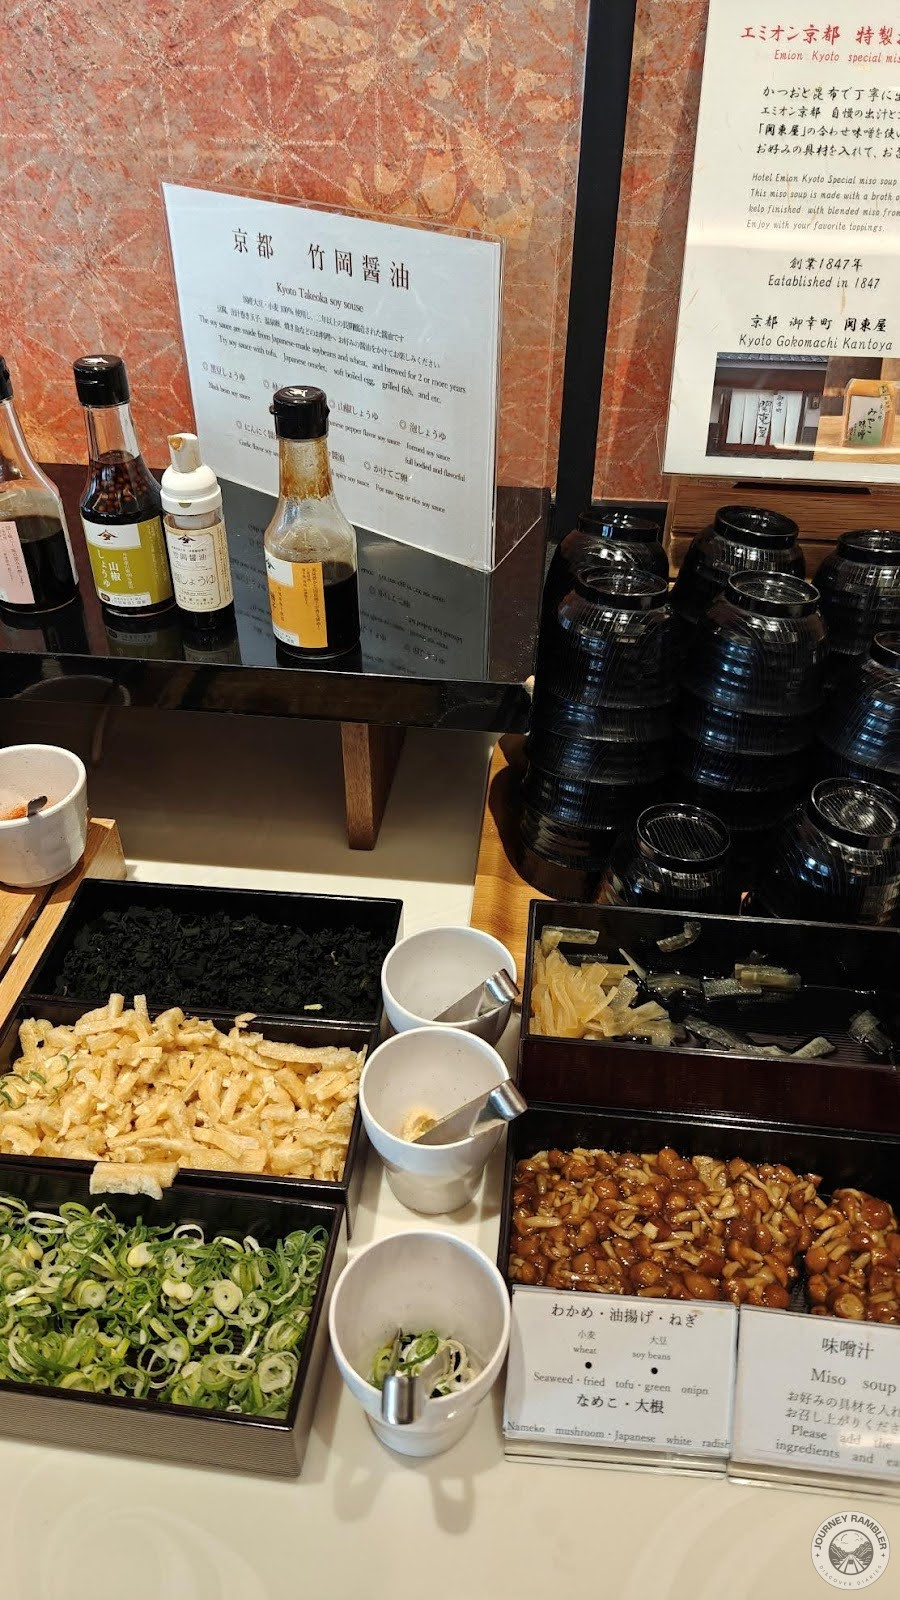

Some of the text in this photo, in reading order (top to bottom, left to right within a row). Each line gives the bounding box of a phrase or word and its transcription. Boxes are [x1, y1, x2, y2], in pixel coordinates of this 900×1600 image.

[741, 24, 900, 46] エミオン京都 特製
[774, 49, 803, 61] Emion
[812, 50, 840, 63] Kyoto
[848, 51, 882, 64] special
[761, 106, 821, 119] エミオン京都
[751, 173, 897, 187] Hotel Emion Kyoto Special miso soup
[750, 188, 766, 198] This
[770, 189, 787, 198] miso
[790, 191, 807, 199] soup
[810, 190, 817, 199] is
[821, 191, 840, 199] made
[844, 191, 860, 200] with
[871, 191, 892, 201] broth
[767, 204, 801, 214] finished
[808, 205, 824, 214] with
[828, 206, 860, 215] blended
[863, 207, 880, 216] miso
[747, 220, 885, 233] Enjoy with your favorite toppings.
[232, 227, 410, 290] 京都 竹岡醤油
[789, 256, 863, 272] 創業1847年
[837, 275, 848, 288] in
[854, 277, 881, 290] 1847
[276, 282, 364, 313] Kyoto Takeoka soy souse
[750, 314, 887, 332] 京都 御幸町 関東屋
[739, 334, 893, 352] Kyoto Gokomachi Kantoya
[199, 314, 209, 324] The
[210, 319, 218, 328] soy
[242, 328, 257, 337] made
[258, 330, 271, 341] from
[312, 347, 337, 359] soybeans
[338, 353, 348, 362] and
[372, 361, 383, 373] and
[384, 364, 406, 379] brewed
[407, 370, 417, 381] for
[423, 376, 430, 384] or
[431, 379, 449, 390] more
[449, 383, 467, 394] years
[218, 335, 228, 344] Try
[229, 340, 238, 349] soy
[283, 352, 307, 367] Japanese
[333, 367, 345, 378] soft
[345, 369, 363, 382] boiled
[382, 381, 400, 393] grilled
[417, 391, 430, 401] and
[551, 1303, 699, 1328] わかめ・油揚げ・ねぎ
[577, 1329, 669, 1346] 小麦 大豆
[573, 1345, 672, 1361] wheat soy beans
[821, 1337, 875, 1360] 味噌汁
[810, 1367, 897, 1397] Miso soup
[576, 1393, 665, 1415] なめこ・大根
[507, 1421, 546, 1433] Nameko
[666, 1434, 693, 1446] white
[791, 1424, 893, 1450] Please add the
[775, 1438, 840, 1460] ingredients
[851, 1452, 875, 1465] and
